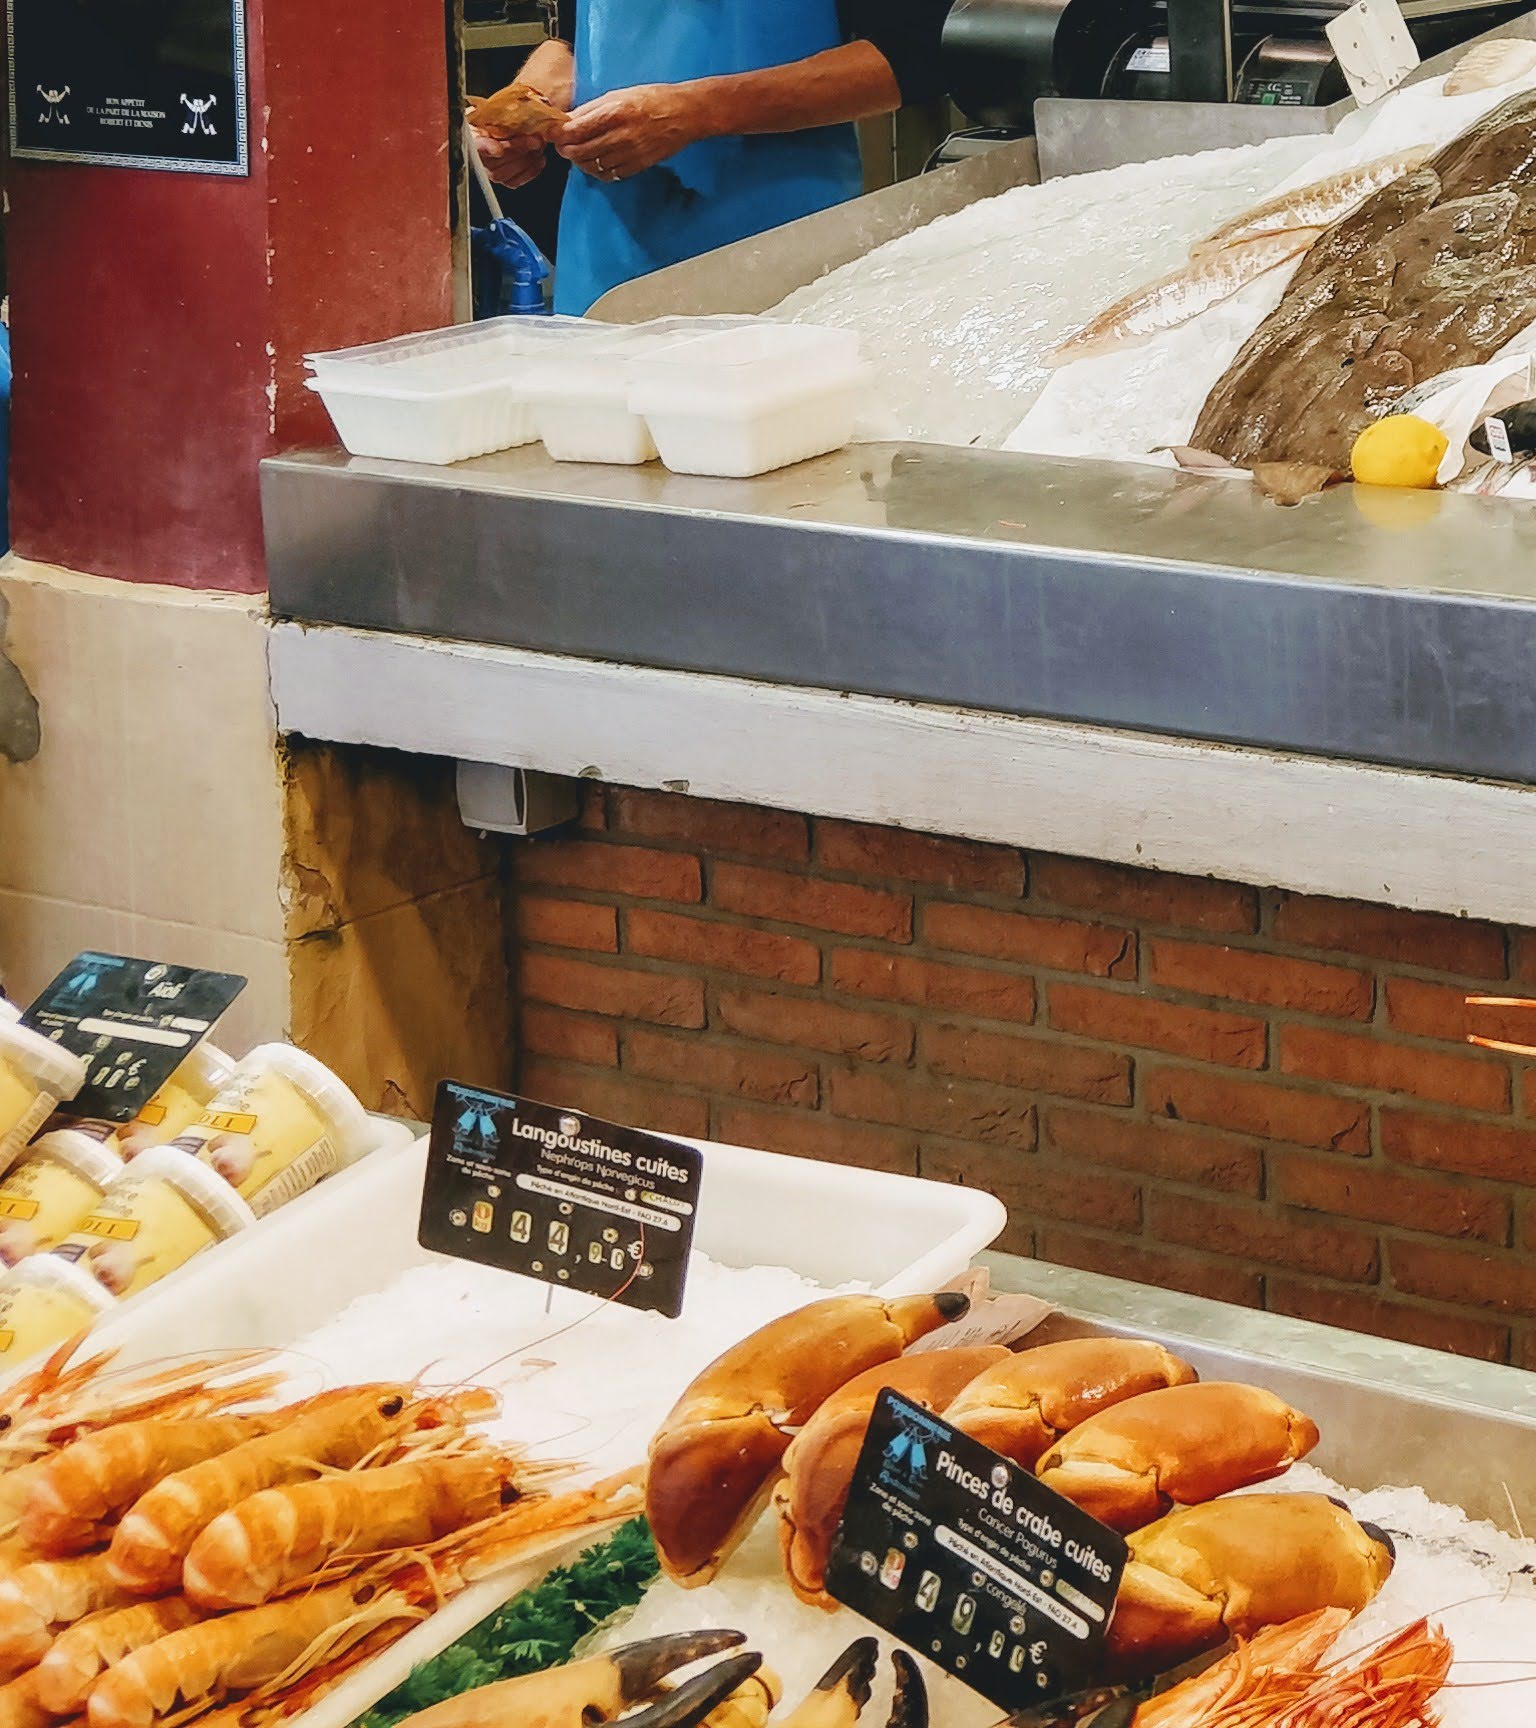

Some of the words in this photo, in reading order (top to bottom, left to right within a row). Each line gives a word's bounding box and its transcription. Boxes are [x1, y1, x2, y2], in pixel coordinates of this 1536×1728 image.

[511, 1118, 632, 1168] Langoustines
[635, 1154, 689, 1184] cuites
[540, 1148, 596, 1174] Nephrops
[596, 1163, 656, 1190] Norvegicus
[935, 1450, 990, 1499] Pinces
[992, 1486, 1014, 1514] de
[1015, 1505, 1062, 1548] crabe
[1064, 1538, 1112, 1583] cuites
[978, 1508, 1015, 1541] Cancer
